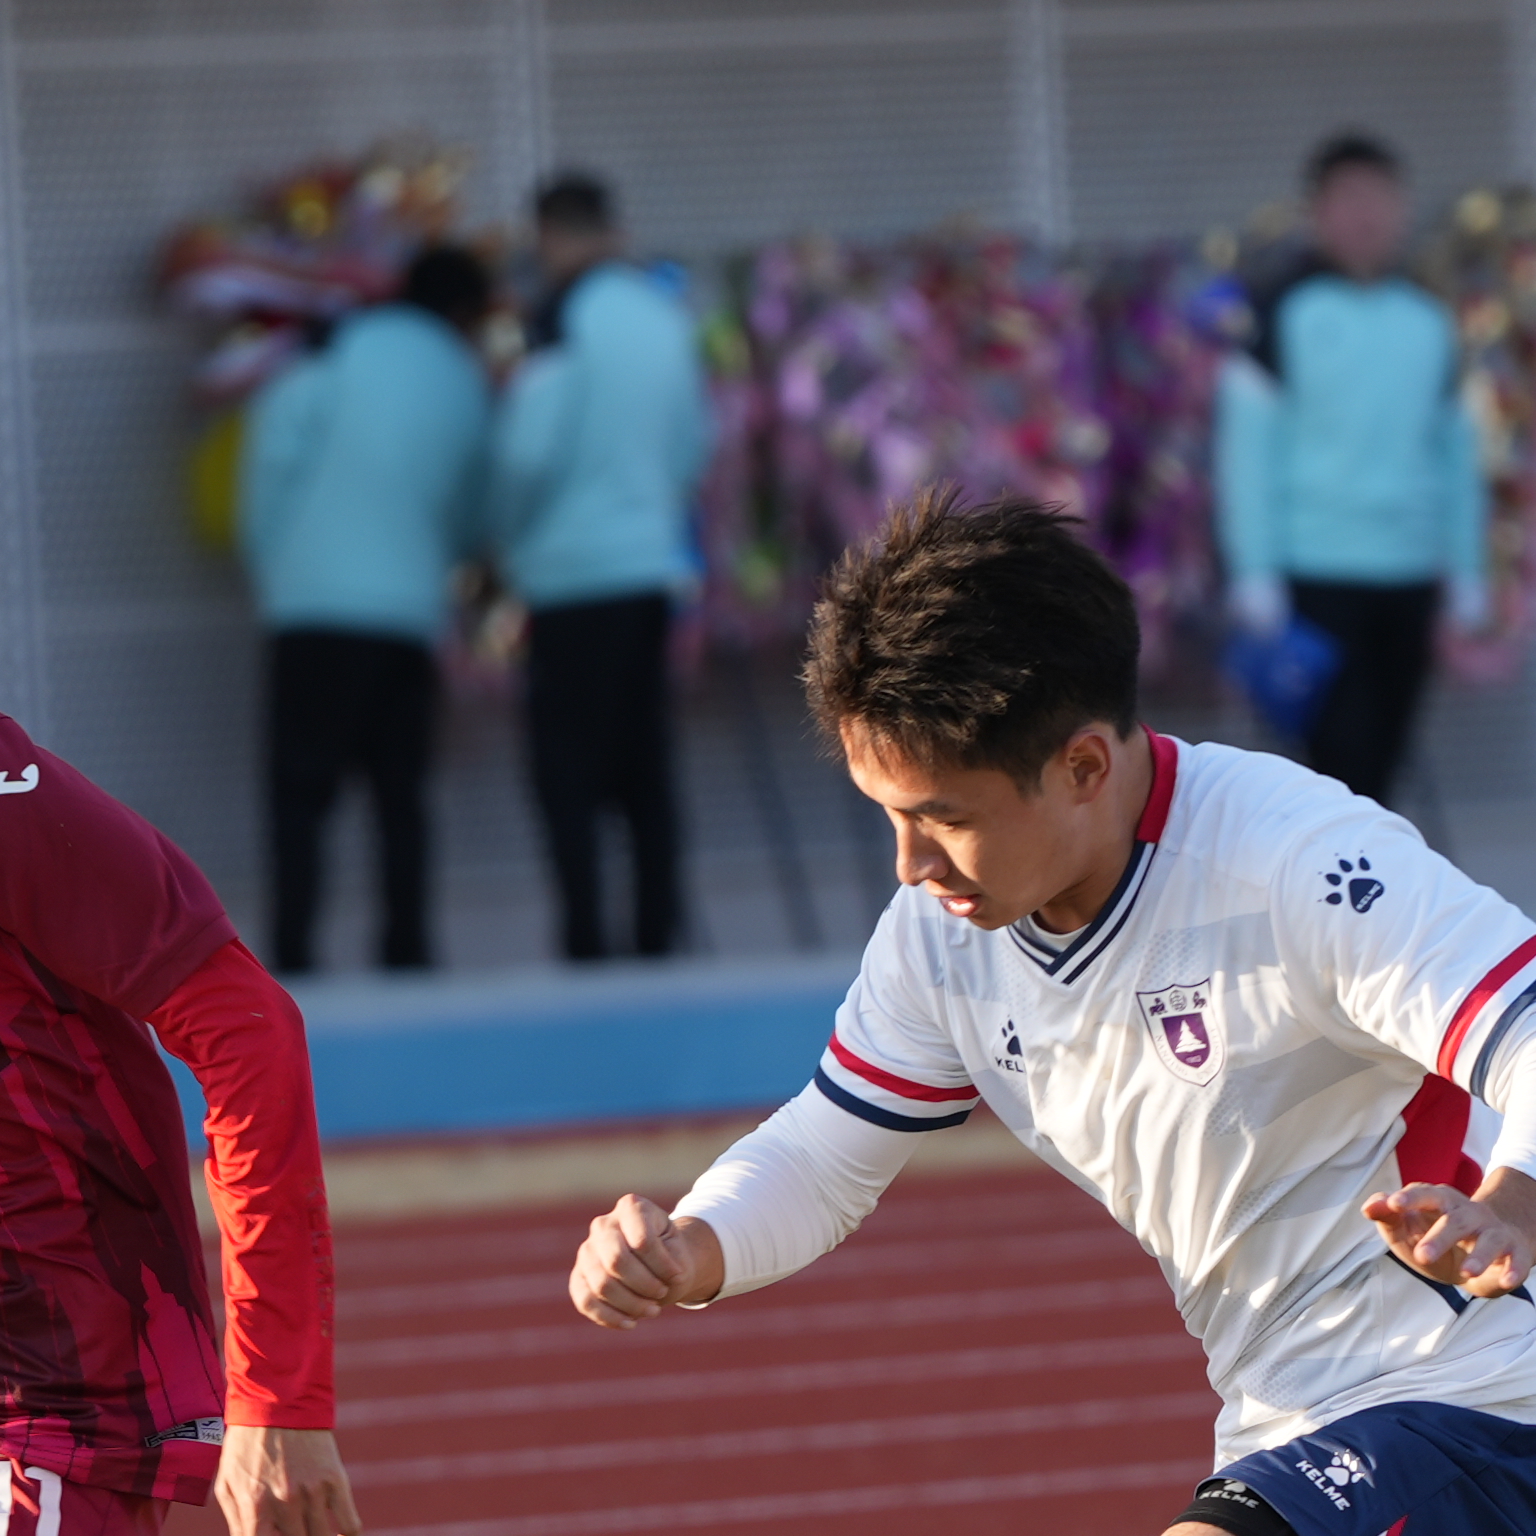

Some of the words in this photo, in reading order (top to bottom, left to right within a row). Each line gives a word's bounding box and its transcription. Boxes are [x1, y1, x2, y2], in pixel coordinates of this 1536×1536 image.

[995, 1056, 1024, 1073] KEL
[1295, 1460, 1351, 1511] KELME
[1199, 1490, 1260, 1509] KELME
